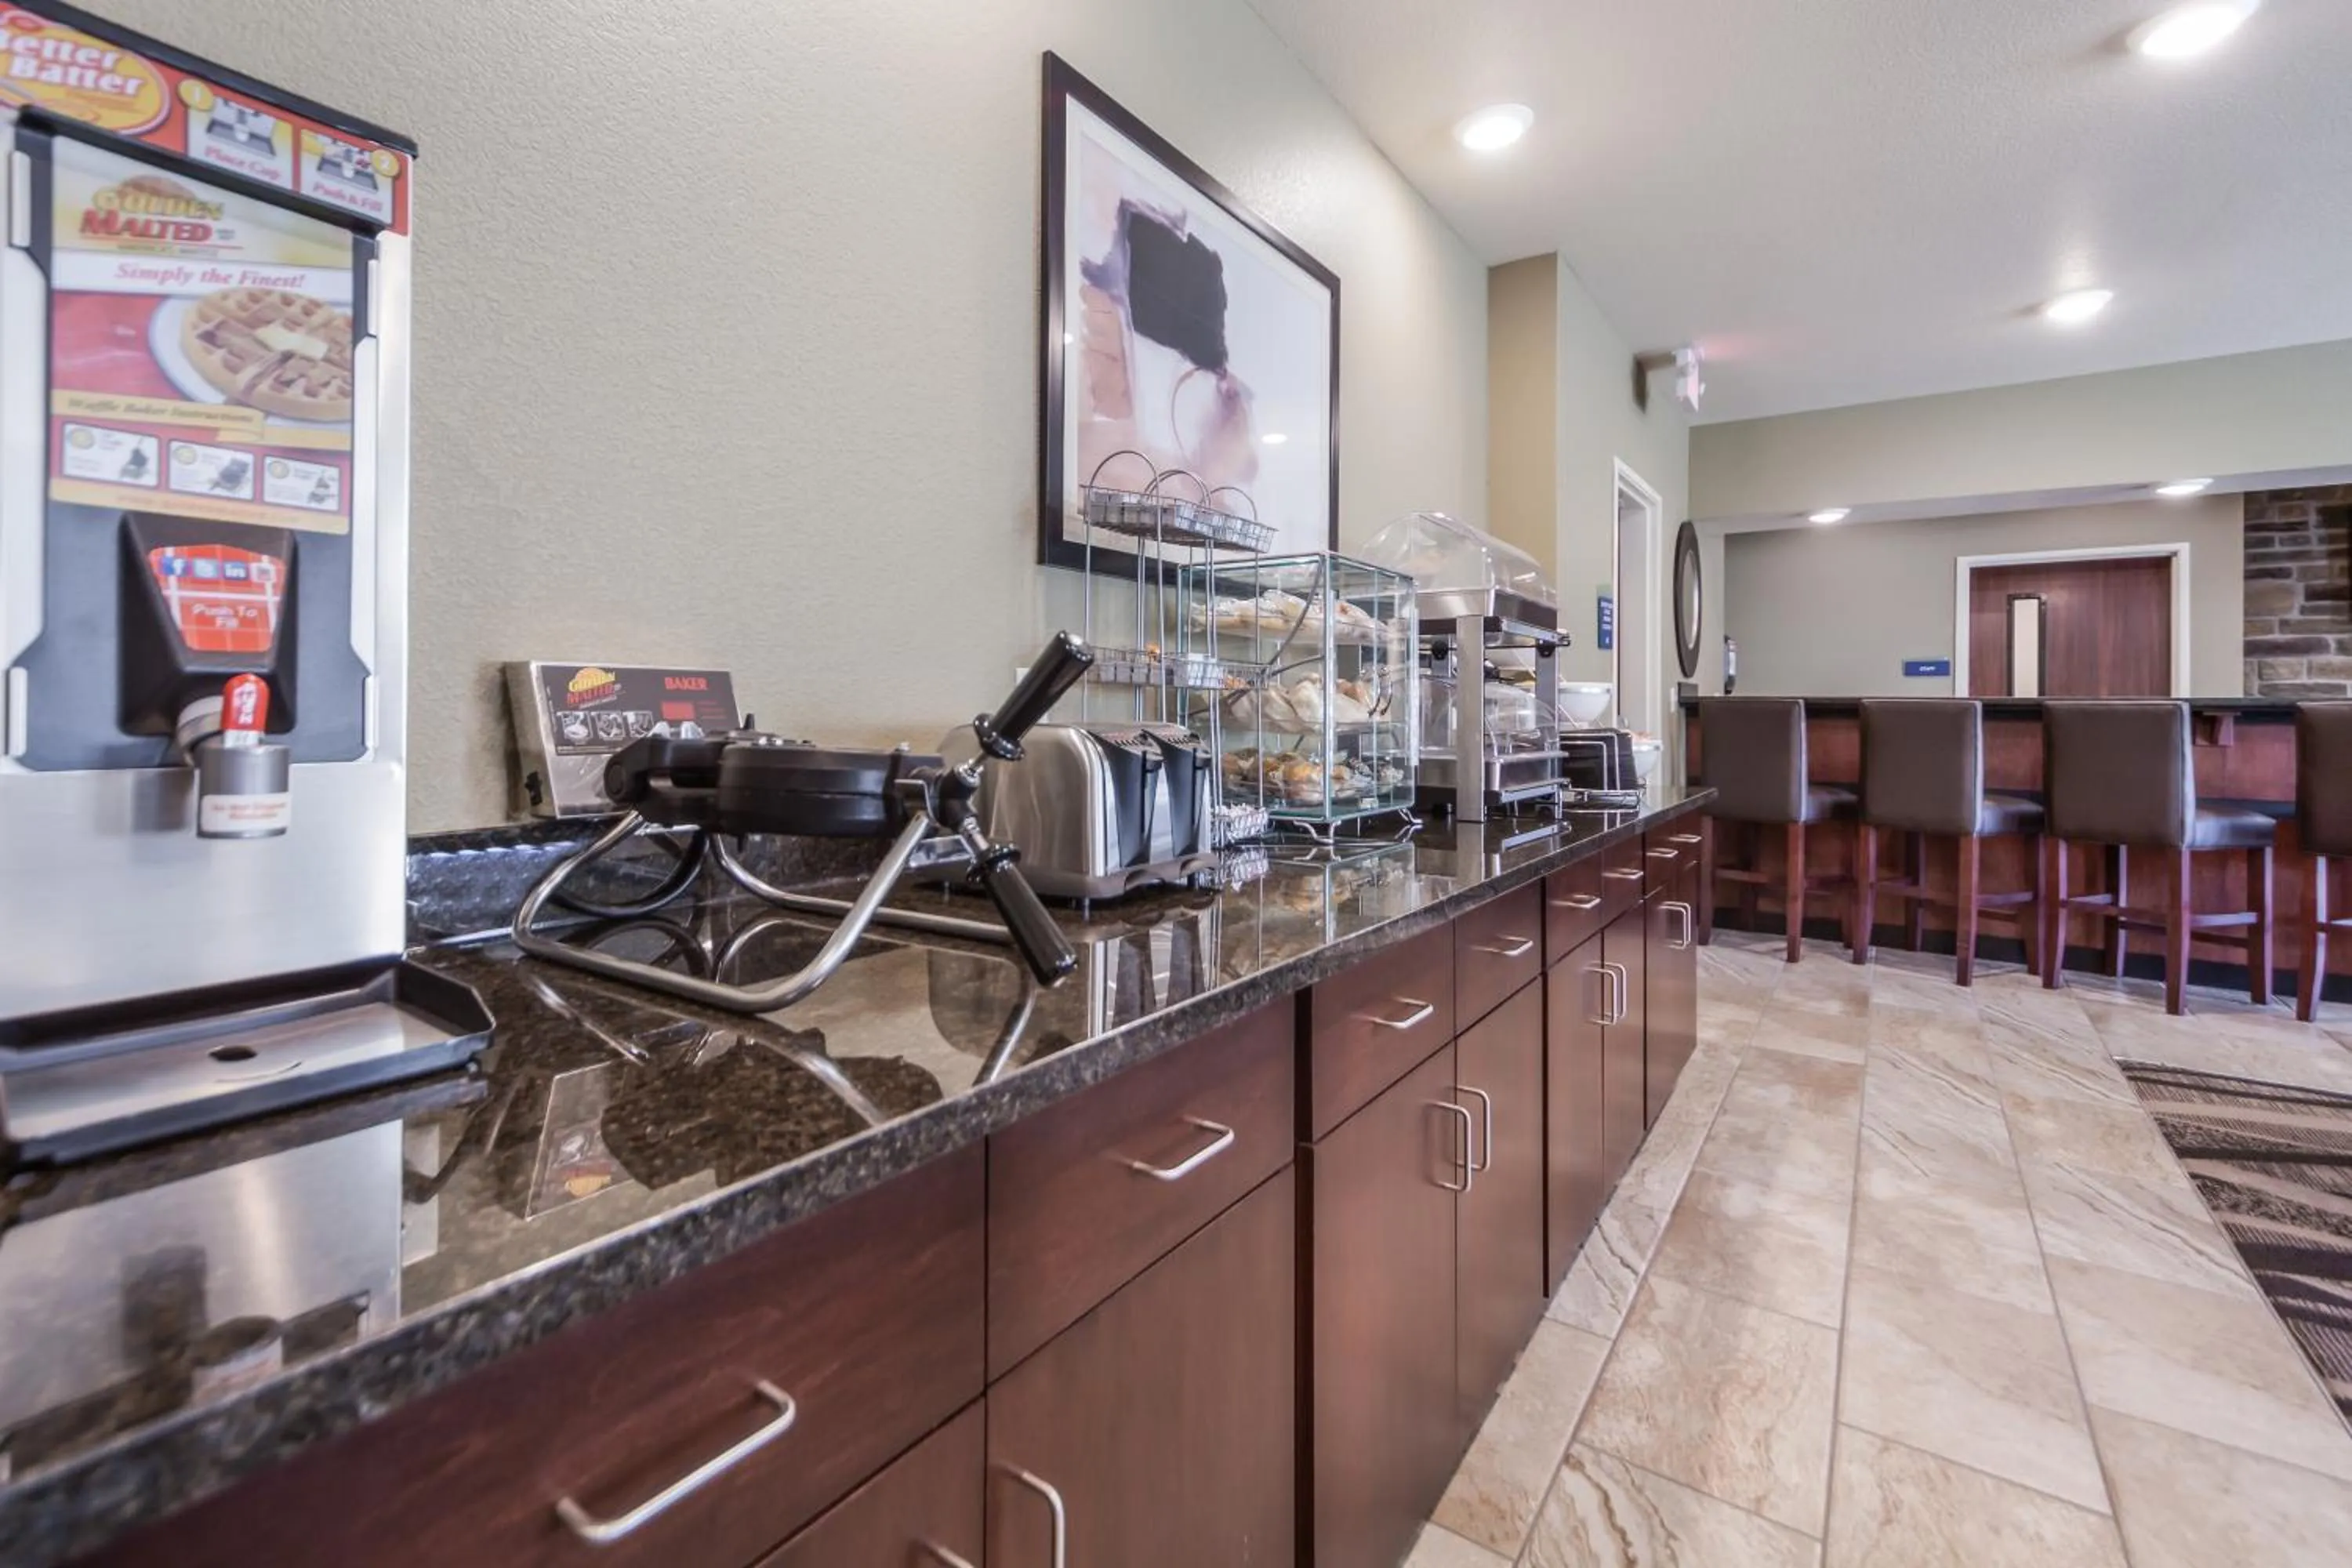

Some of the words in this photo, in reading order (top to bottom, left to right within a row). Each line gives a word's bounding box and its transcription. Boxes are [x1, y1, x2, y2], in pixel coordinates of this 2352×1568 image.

[9, 55, 144, 96] Batter
[79, 207, 213, 243] MALTED
[116, 263, 194, 286] Simply
[200, 267, 233, 285] the
[238, 270, 306, 288] Finest!
[664, 676, 709, 691] BAKER
